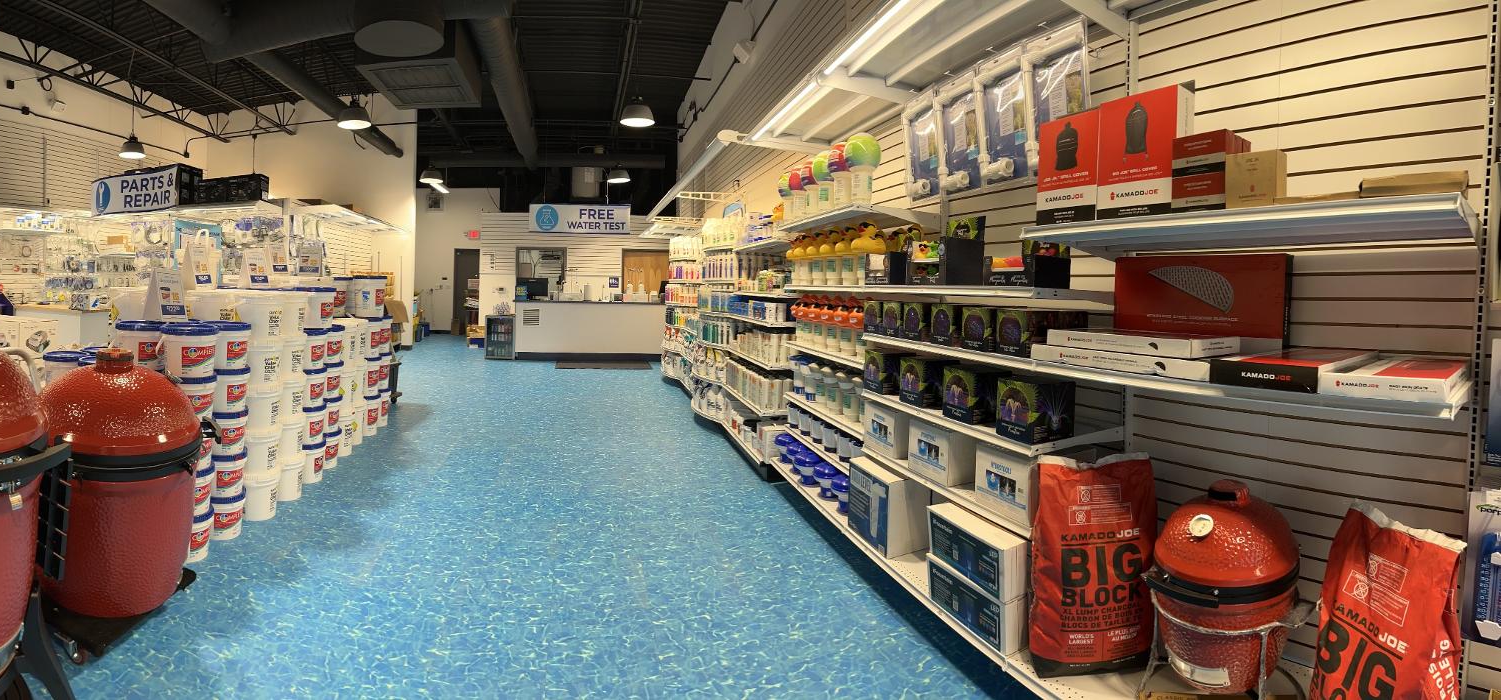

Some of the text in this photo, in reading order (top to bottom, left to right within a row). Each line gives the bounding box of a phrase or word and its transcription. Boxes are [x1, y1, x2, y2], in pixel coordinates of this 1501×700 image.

[120, 172, 174, 194] PARTS &
[123, 189, 171, 208] REPAIR
[579, 208, 615, 220] FREE
[566, 221, 627, 231] WATER TEST
[1241, 371, 1292, 381] KAMADOJOE
[1480, 507, 1501, 516] porp
[1061, 527, 1141, 542] KAMADOJOE
[1060, 543, 1143, 589] BIG
[1061, 582, 1142, 608] BLOCK
[1317, 620, 1397, 700] BIG
